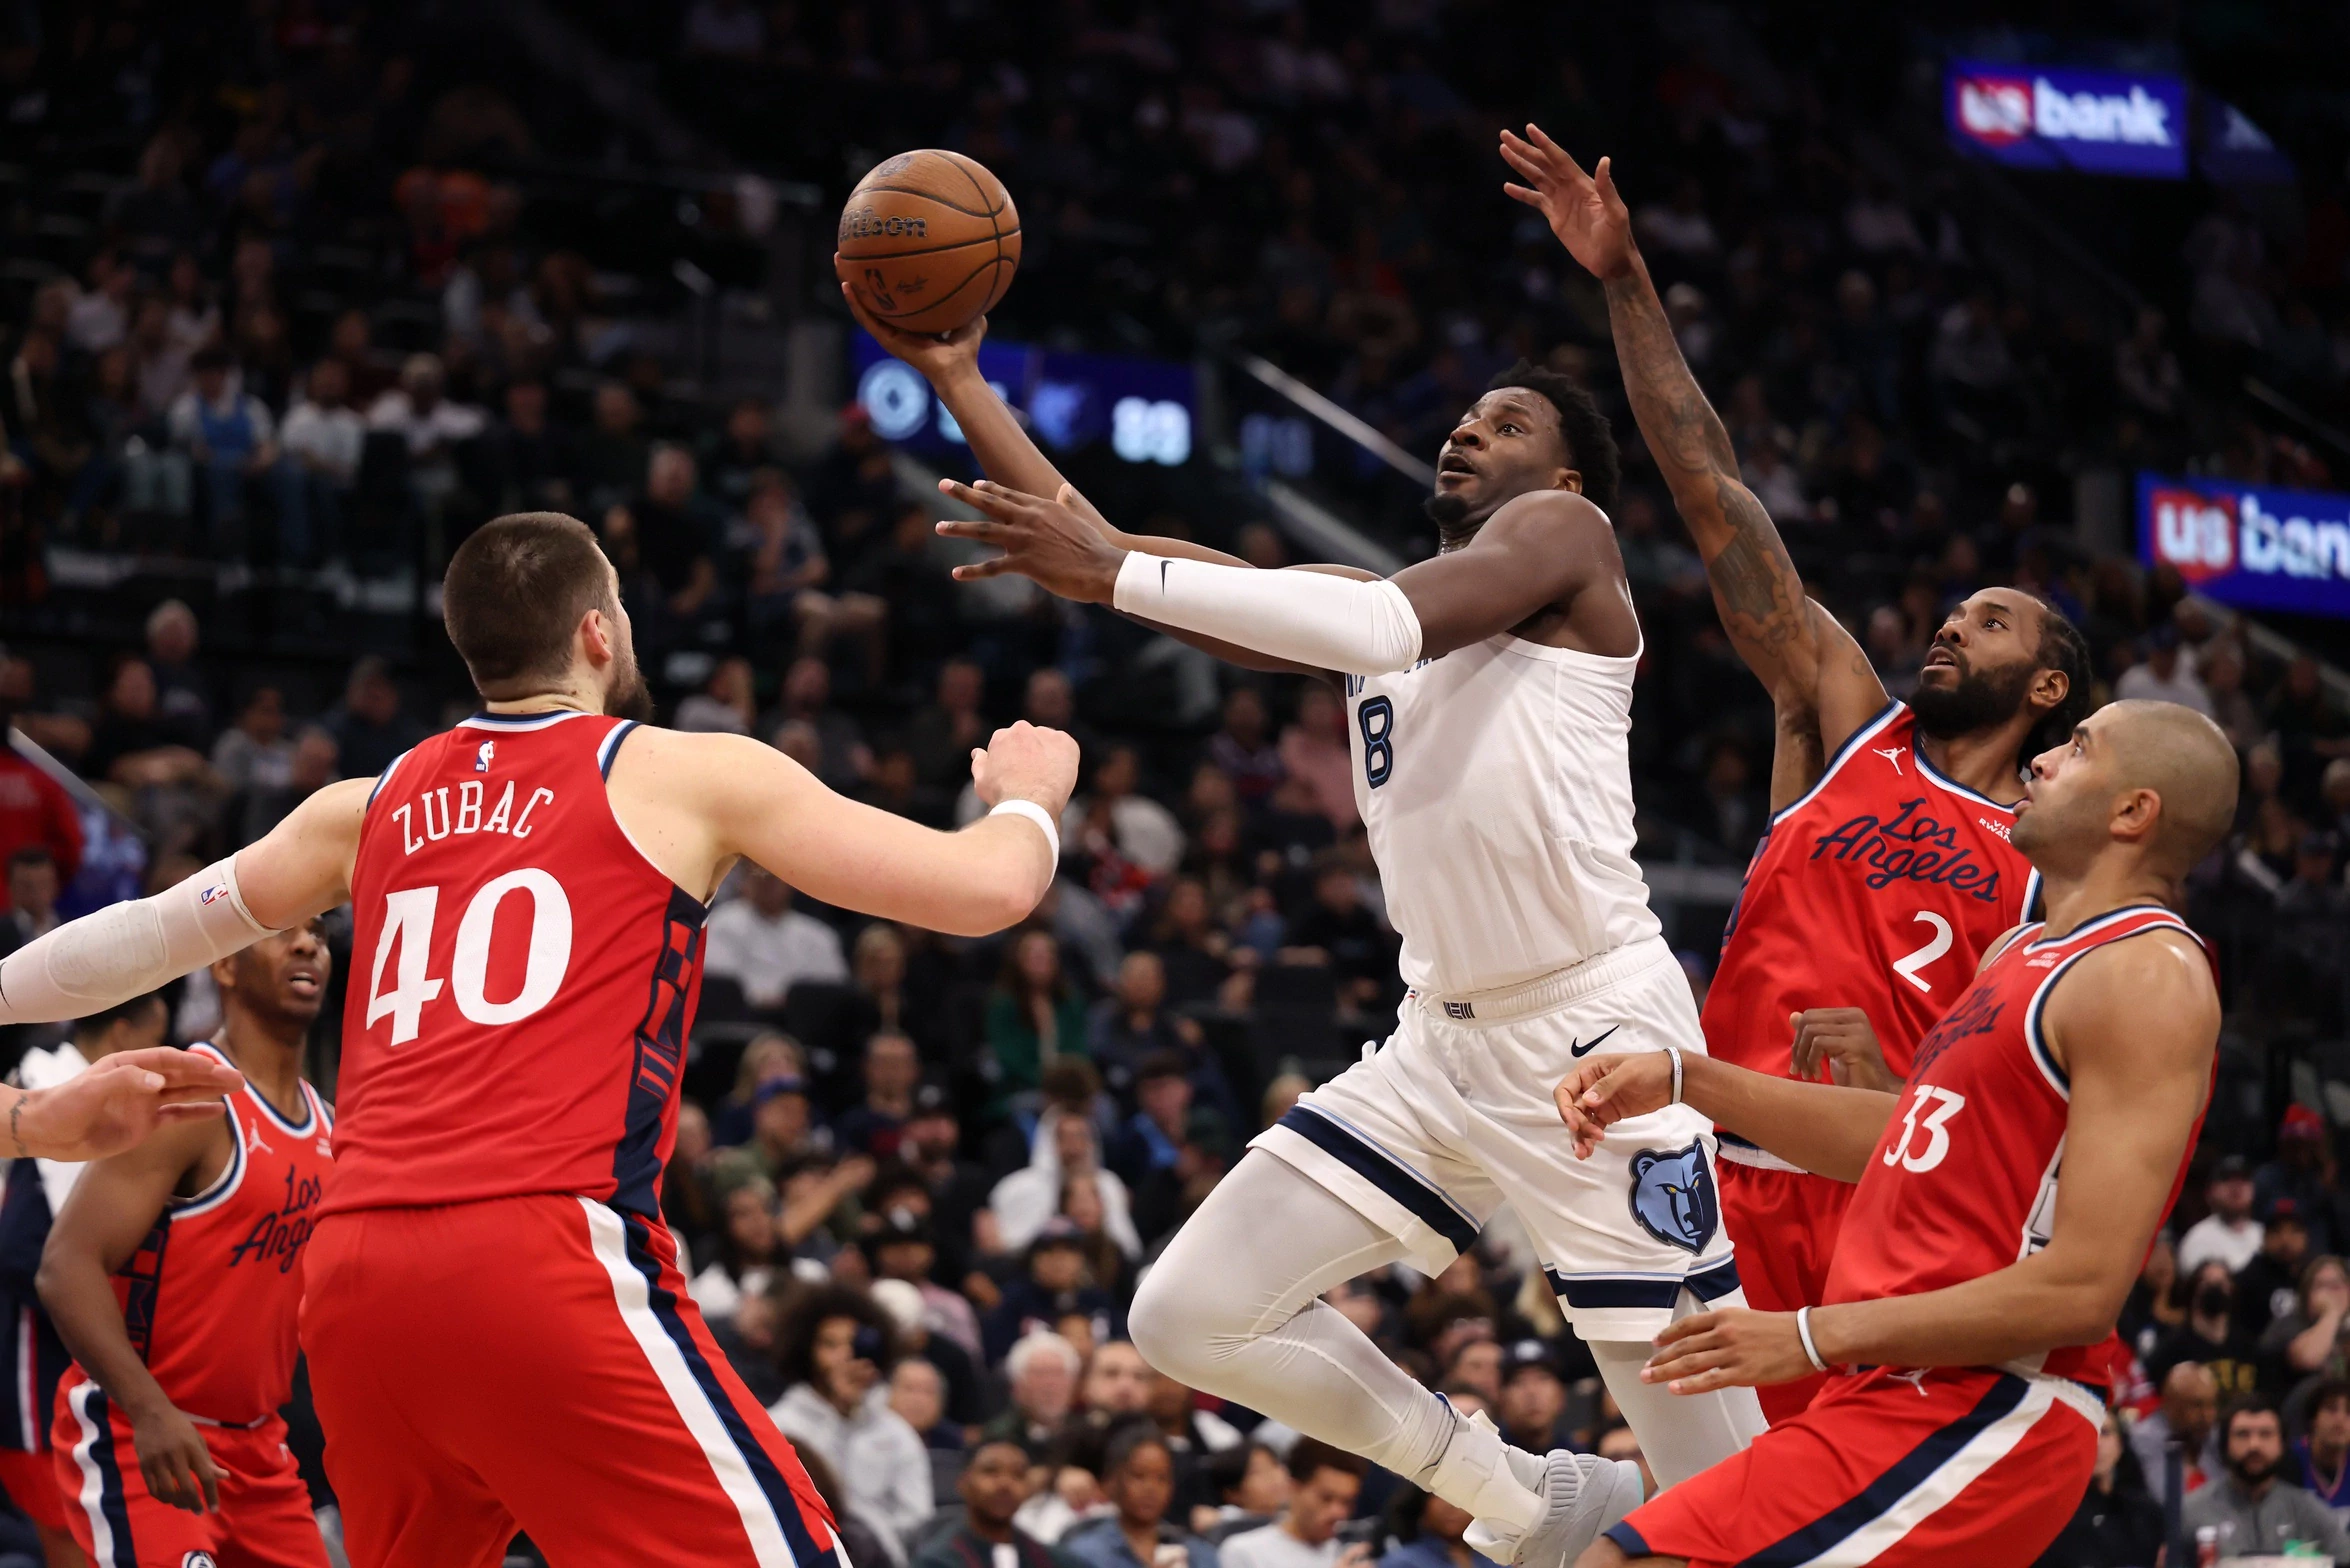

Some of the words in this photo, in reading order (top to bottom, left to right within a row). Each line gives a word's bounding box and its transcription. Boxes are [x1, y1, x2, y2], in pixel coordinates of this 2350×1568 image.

[2034, 76, 2169, 146] bank
[2156, 501, 2232, 570] us
[2240, 492, 2350, 581] ban
[1358, 695, 1393, 789] 8
[392, 780, 554, 856] ZUBAC
[1879, 797, 1957, 850] Los
[1979, 817, 2011, 844] RWAN
[1994, 819, 2011, 835] VIS
[1810, 815, 2000, 903] Angeles
[366, 867, 573, 1047] 40
[1893, 910, 1953, 994] 2
[1883, 1084, 1966, 1174] 33
[281, 1163, 322, 1216] Los
